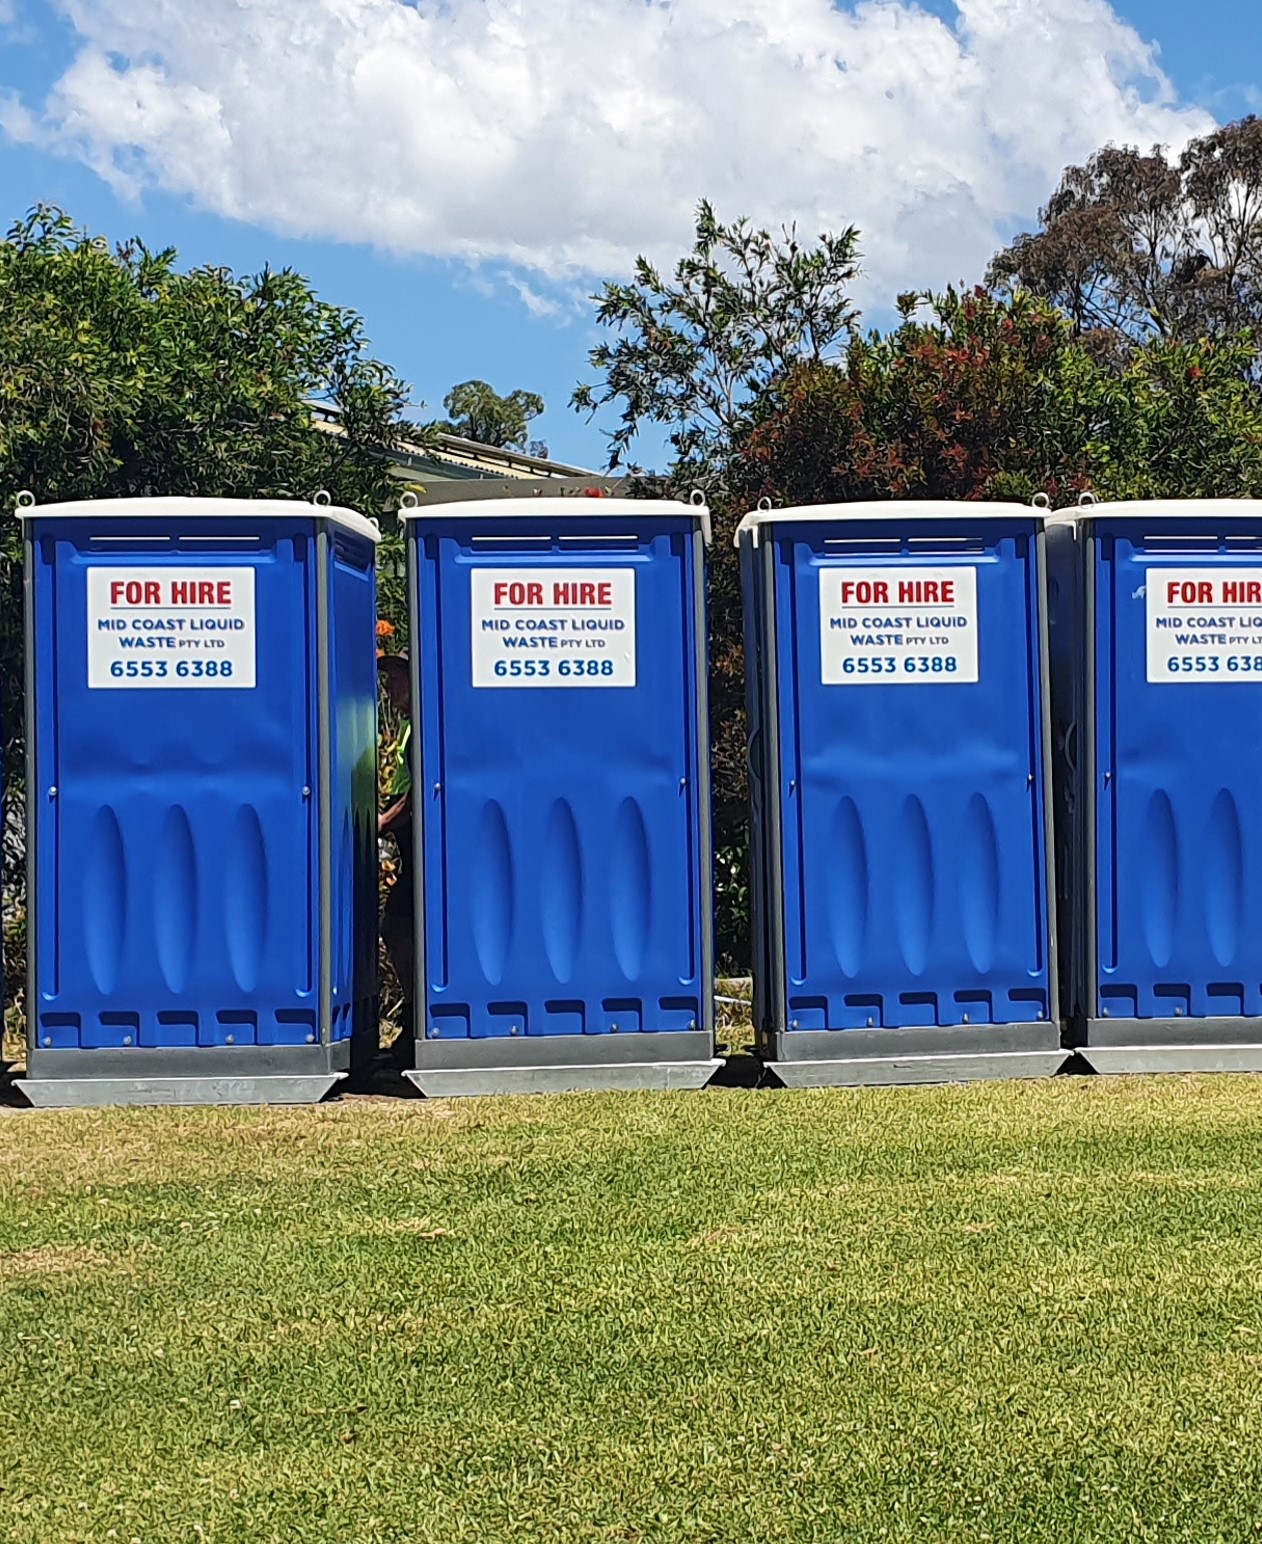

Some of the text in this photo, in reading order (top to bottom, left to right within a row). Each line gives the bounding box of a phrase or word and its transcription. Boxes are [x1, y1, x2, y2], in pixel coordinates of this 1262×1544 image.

[110, 580, 232, 605] FOR HIRE
[493, 581, 613, 606] FOR HIRE
[841, 580, 955, 604] FOR HIRE
[1167, 580, 1214, 604] FOR
[97, 618, 245, 631] MID COAST LIQUID
[481, 618, 625, 631] MID COAST LIQUID
[829, 616, 968, 630] MID COAST LIQUID
[1155, 617, 1183, 629] MID
[1186, 616, 1236, 629] COAST
[118, 636, 225, 649] WASTE PTY LTD
[502, 636, 606, 649] WASTE PTY LTD
[849, 633, 950, 646] WASTE PTY LTD
[1174, 633, 1227, 645] WASTE
[1228, 636, 1249, 645] PTY
[109, 659, 233, 678] 6553 6388
[493, 659, 614, 677] 6553 6388
[842, 656, 958, 674] 6553 6388
[1167, 655, 1220, 673] 6553
